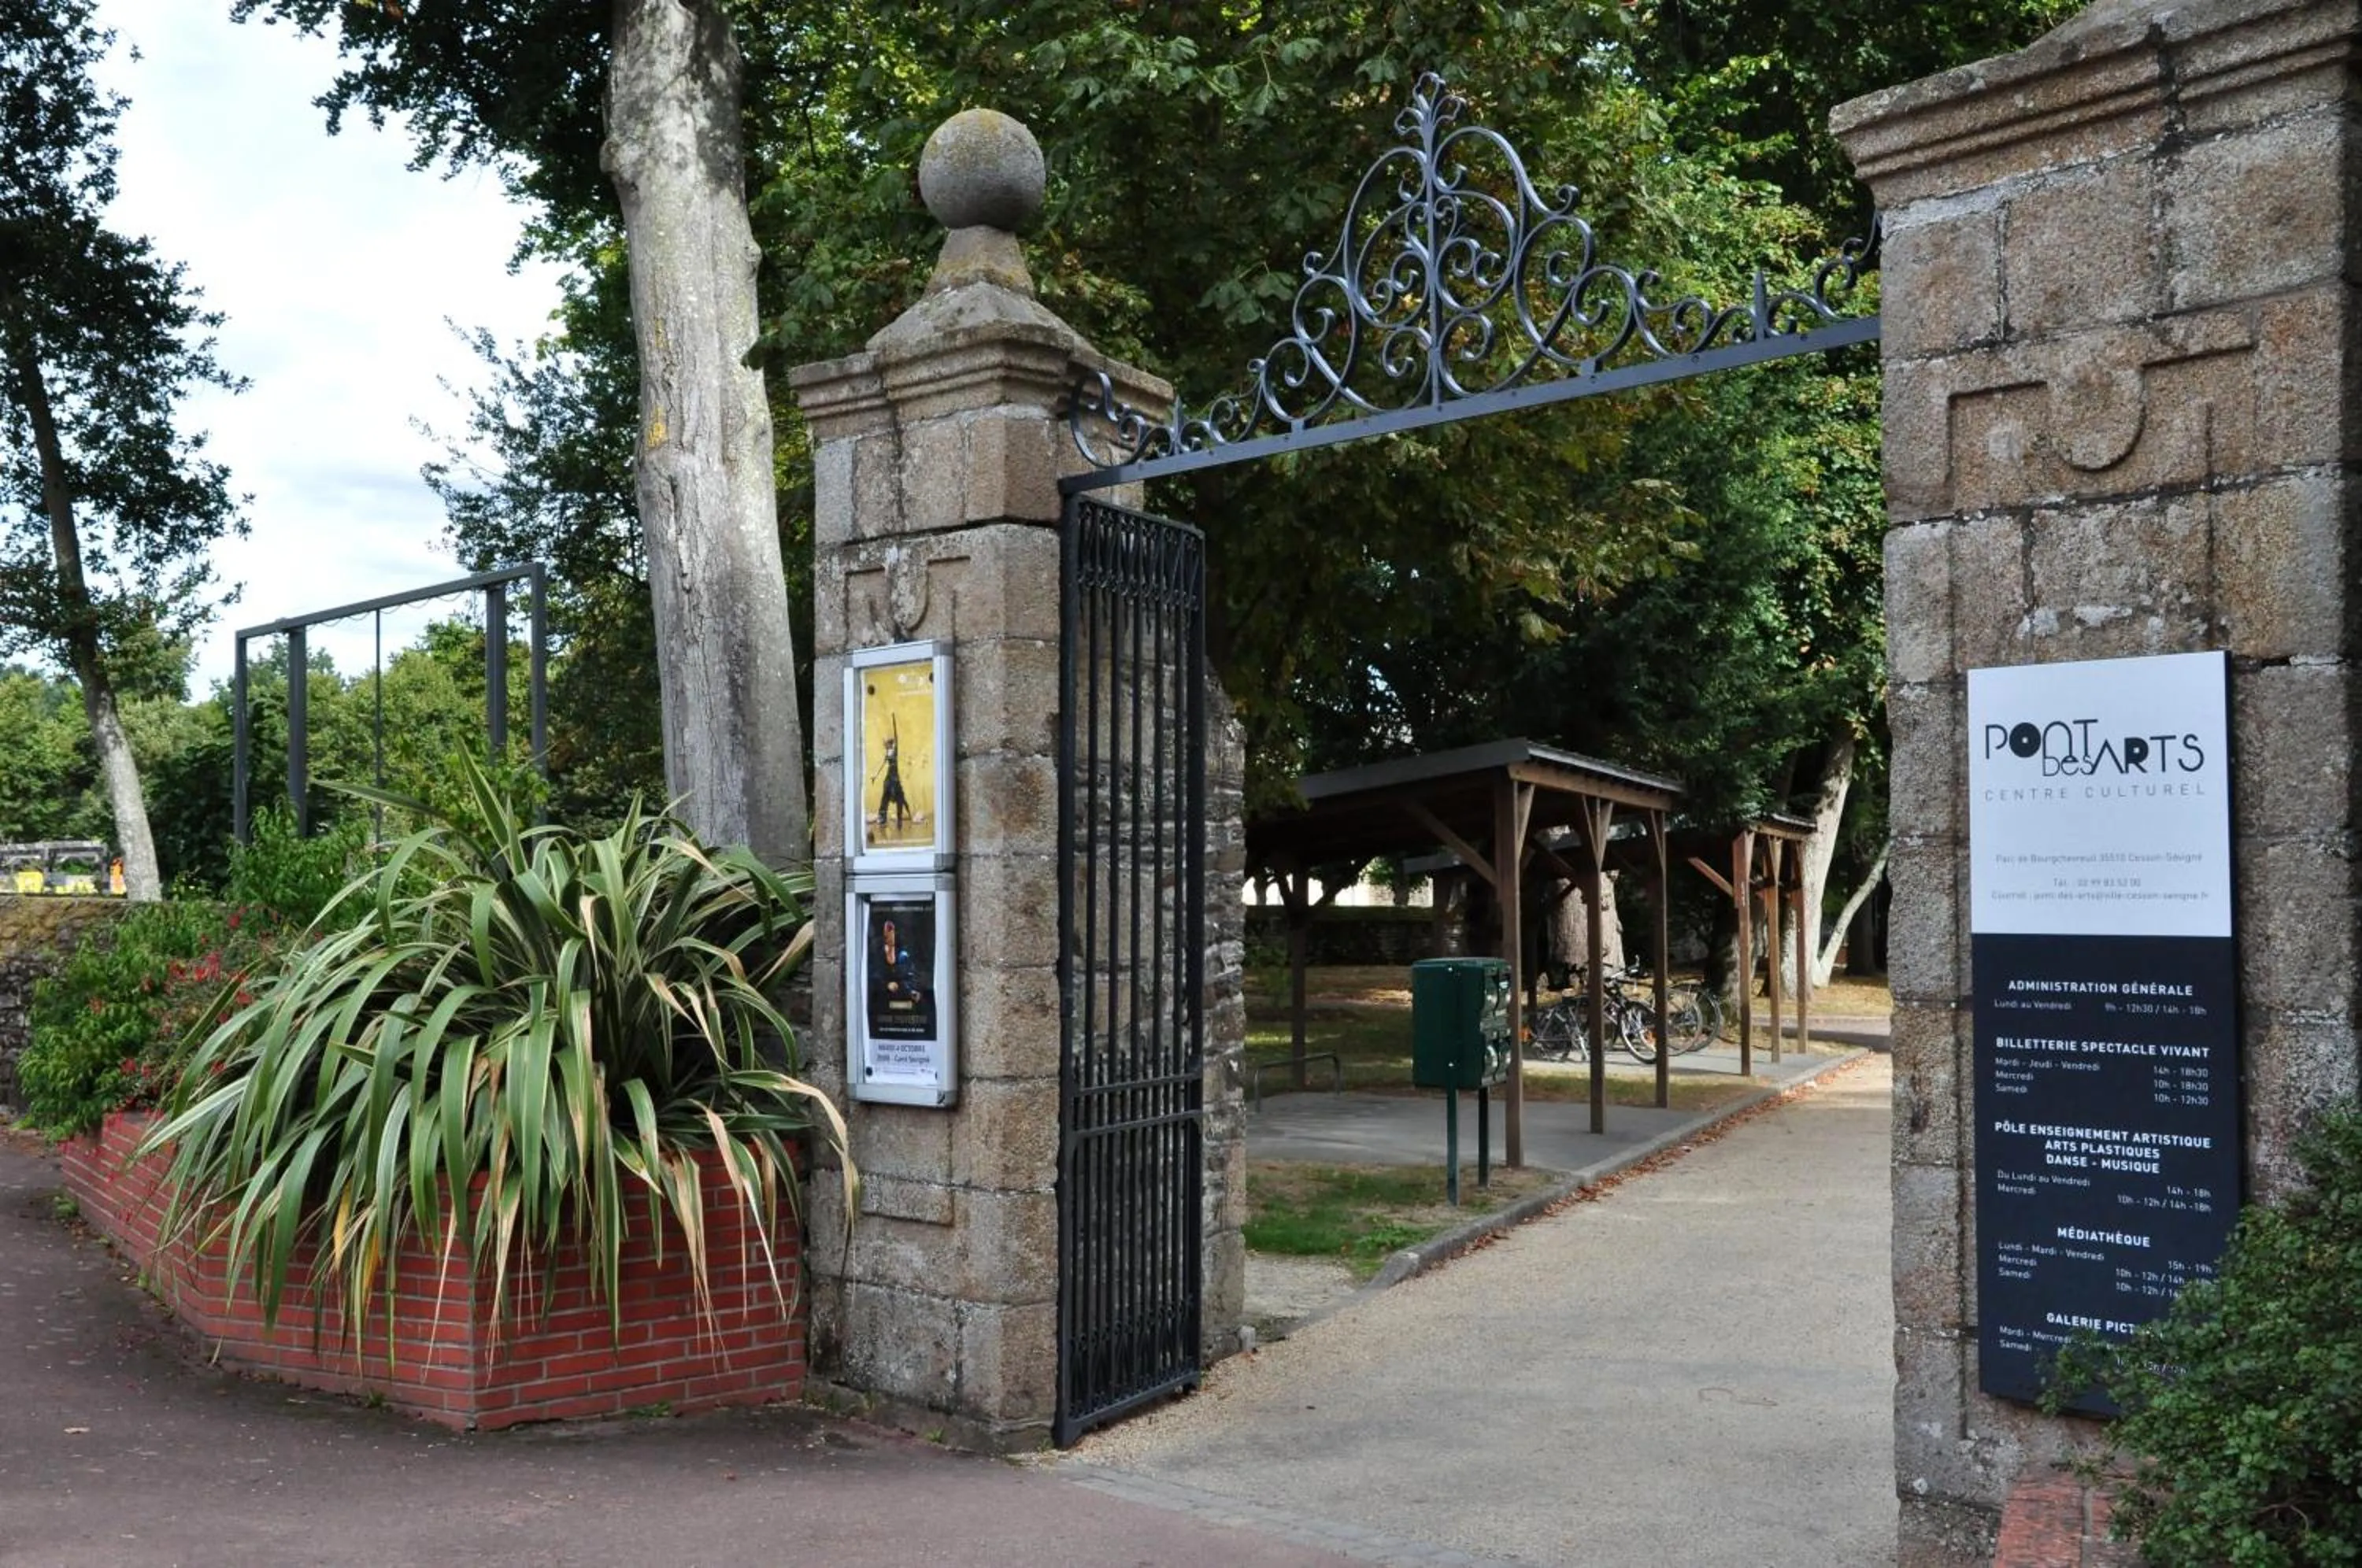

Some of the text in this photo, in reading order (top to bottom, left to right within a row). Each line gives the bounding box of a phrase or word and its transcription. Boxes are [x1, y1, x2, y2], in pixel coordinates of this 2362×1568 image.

[2090, 733, 2205, 775] ARTS
[1985, 782, 2205, 801] CENTRE CULTUREL
[2008, 980, 2194, 997] ADMINISTRATION GÉNÉRALE
[2126, 1003, 2154, 1014] 12h30
[1996, 1036, 2210, 1059] BILLETTERIE SPECTACLE VIVANT
[1995, 1070, 2034, 1081] Mercredi
[2029, 1059, 2053, 1069] Jeudi
[2060, 1060, 2101, 1071] Vendredi
[1994, 1082, 2029, 1093] Samedi
[2153, 1093, 2171, 1103] 10h
[2181, 1094, 2209, 1106] 12h30
[1994, 1119, 2212, 1149] PÔLE ENSEIGNEMENT ARTISTIQUE
[2045, 1139, 2160, 1159] ARTS PLASTIQUES
[2046, 1153, 2089, 1167] DANSE
[2101, 1158, 2160, 1174] MUSIQUE
[1997, 1169, 2010, 1179] Du
[2012, 1170, 2037, 1182] Lundi
[2051, 1174, 2090, 1187] Vendredi
[2167, 1185, 2184, 1196] 14h
[1997, 1183, 2037, 1195] Mercredi
[2143, 1196, 2160, 1207] 12h
[2169, 1199, 2187, 1211] 14h
[2057, 1226, 2151, 1248] MÉDIATHÈQUE
[1998, 1253, 2038, 1267] Mercredi
[2142, 1270, 2160, 1281] 12h
[2168, 1274, 2186, 1285] 14h
[2031, 1244, 2057, 1256] Mardi
[2065, 1248, 2105, 1261] Vendredi
[2168, 1259, 2186, 1271] 15h
[2194, 1263, 2213, 1275] 19h
[1998, 1267, 2031, 1279] Samedi
[2142, 1285, 2160, 1296] 12h
[1999, 1325, 2024, 1337] Mardi
[2046, 1311, 2135, 1335] GALERIE PICT
[1999, 1339, 2032, 1352] Samedi
